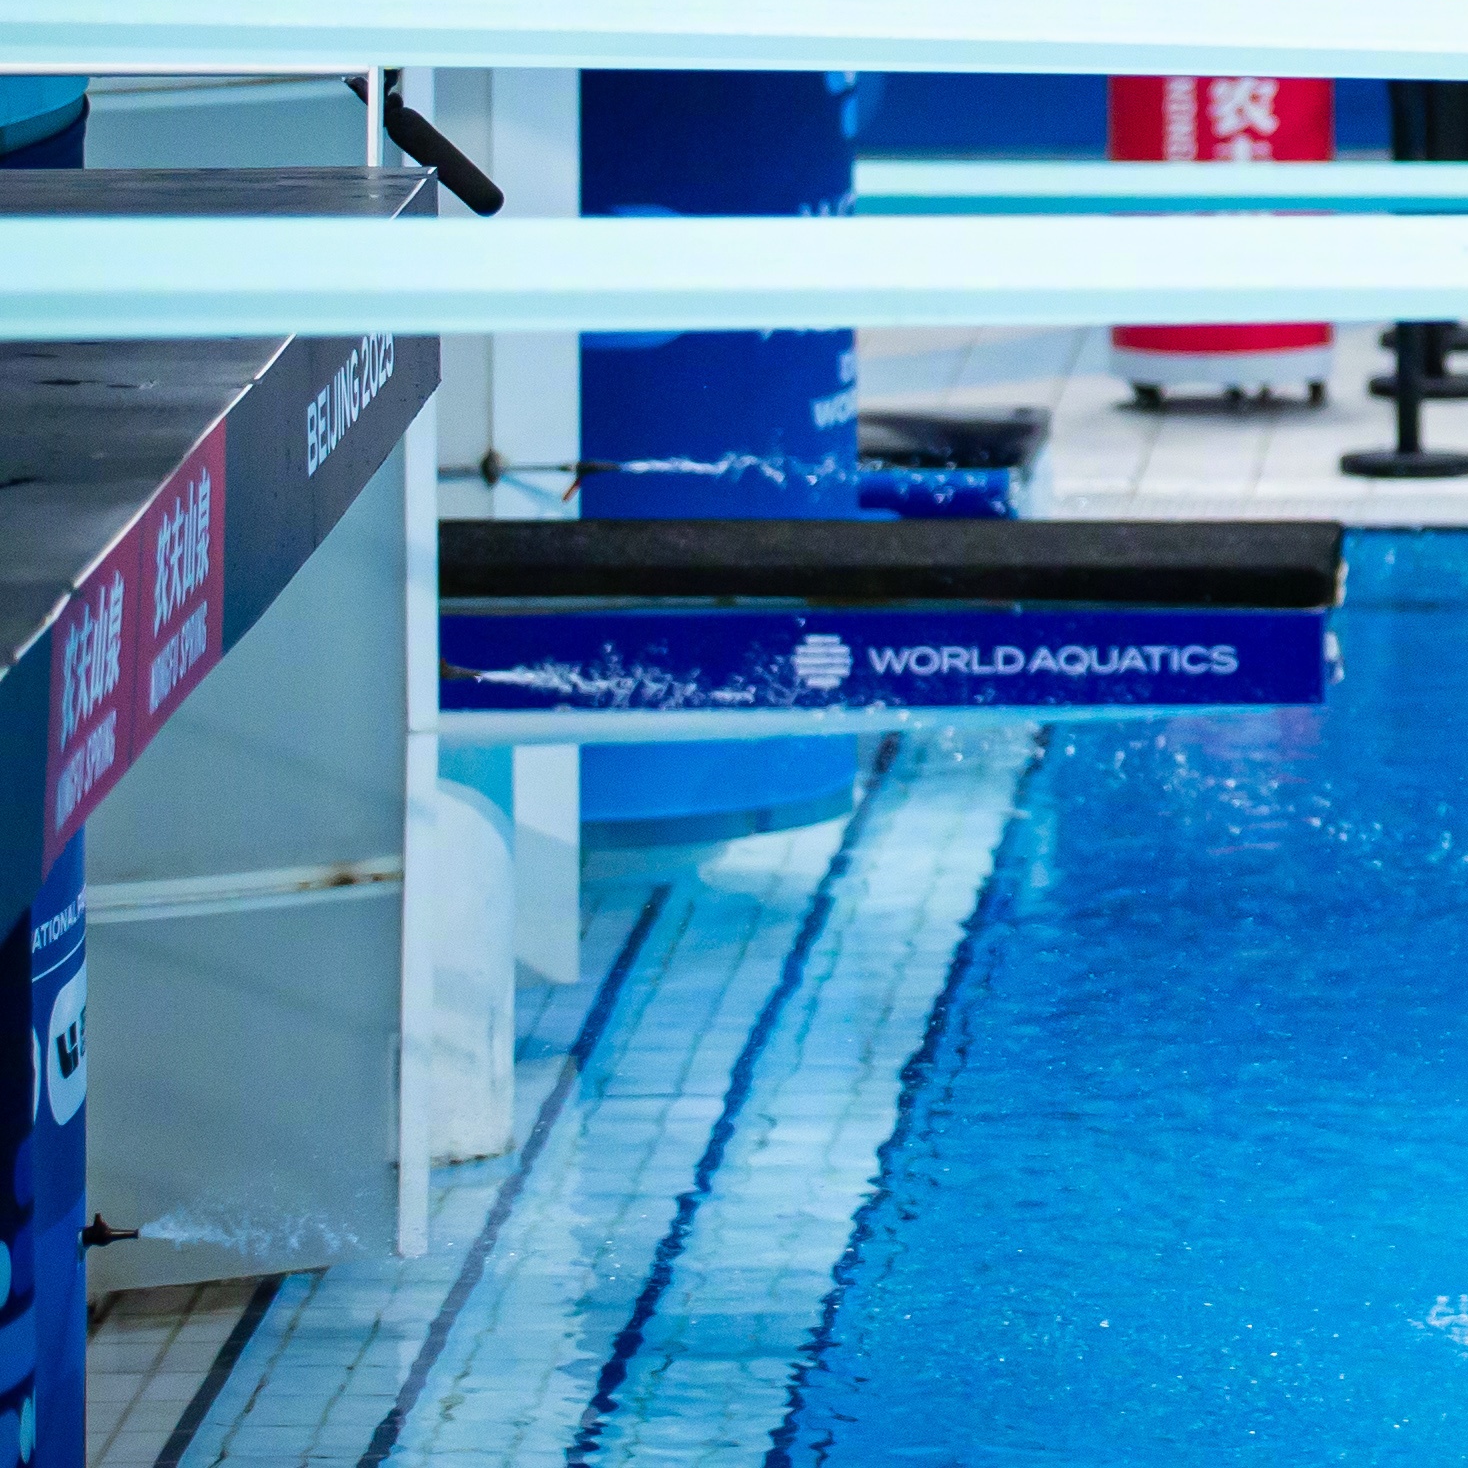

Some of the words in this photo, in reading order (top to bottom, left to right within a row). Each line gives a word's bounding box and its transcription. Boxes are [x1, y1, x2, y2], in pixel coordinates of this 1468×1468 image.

[306, 347, 361, 478] BEIJING
[361, 330, 395, 410] 2025
[867, 644, 1026, 676] WORLD
[1027, 644, 1240, 676] AQUATICS
